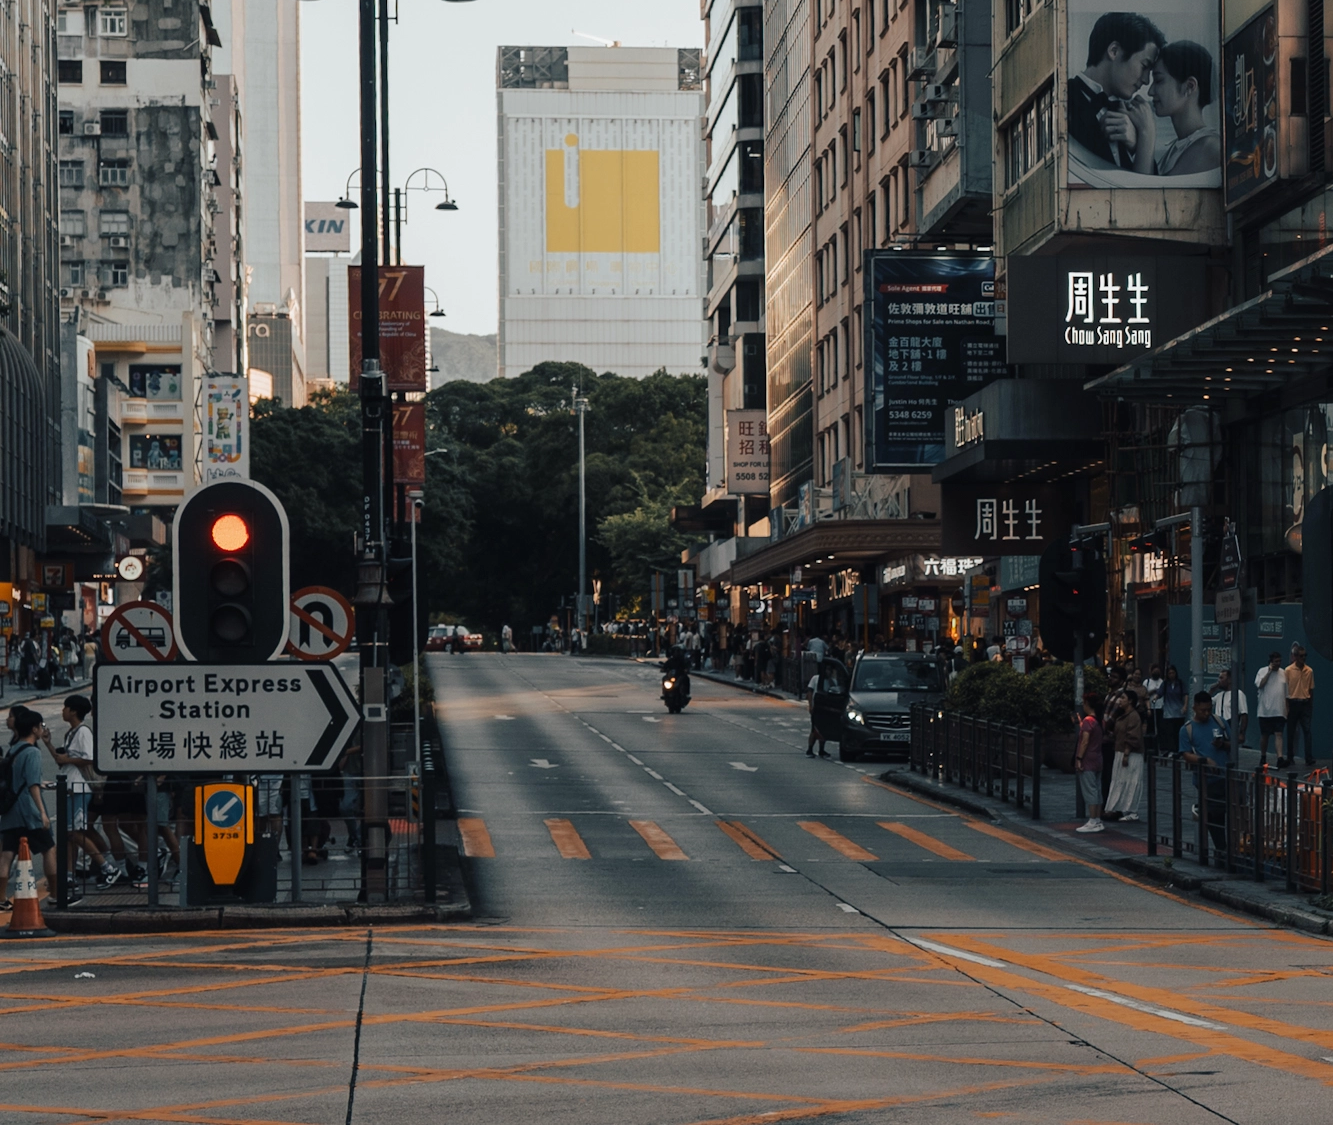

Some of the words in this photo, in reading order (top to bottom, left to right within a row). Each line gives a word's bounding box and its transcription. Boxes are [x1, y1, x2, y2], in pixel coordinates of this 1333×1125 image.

[1065, 271, 1150, 324] 周生生
[1065, 327, 1094, 345] Chow
[1097, 327, 1122, 348] Sang
[1125, 327, 1151, 348] Sang
[889, 411, 910, 419] 5348
[911, 411, 932, 419] 6259
[974, 498, 1044, 541] 周生生
[924, 558, 984, 575] 六福珠
[108, 674, 196, 698] Airport
[203, 673, 303, 696] Express
[159, 700, 250, 720] Station
[111, 729, 286, 761] 機場快綫站
[212, 832, 239, 840] 3738
